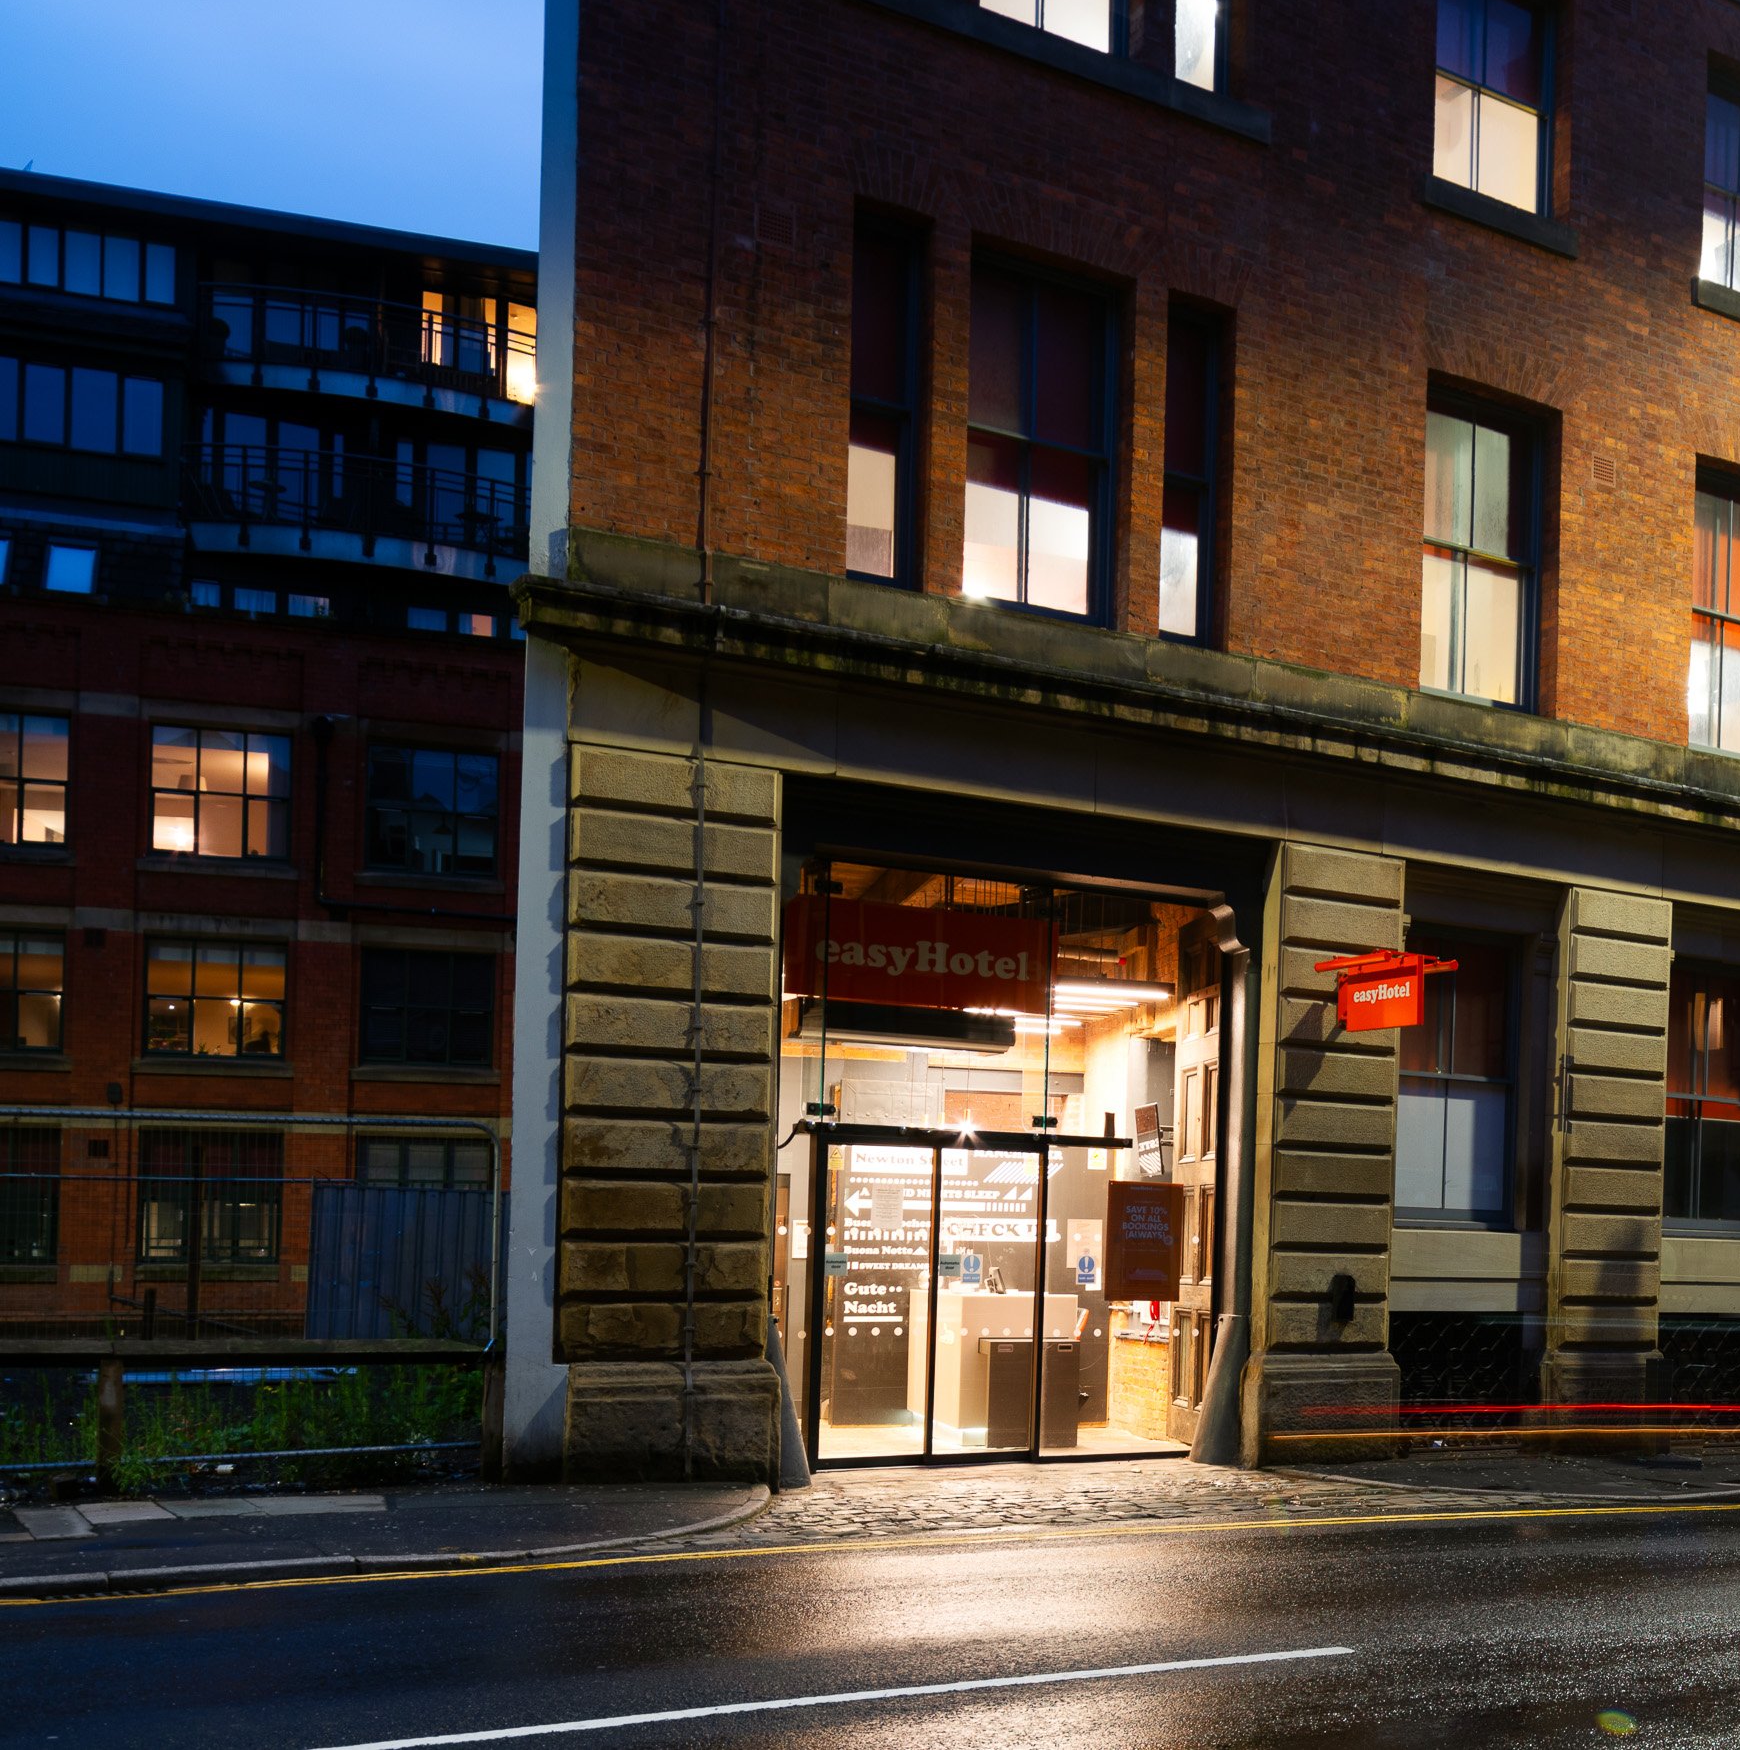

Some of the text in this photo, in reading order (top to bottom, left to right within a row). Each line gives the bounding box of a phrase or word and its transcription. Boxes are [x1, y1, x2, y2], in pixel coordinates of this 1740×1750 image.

[815, 938, 1030, 982] easyHotel
[1352, 981, 1411, 1005] easyHotel
[855, 1153, 915, 1166] Newton
[918, 1155, 964, 1168] Steet
[1126, 1206, 1147, 1215] SAVE
[1131, 1214, 1162, 1224] ON ALL
[1122, 1222, 1169, 1232] BOOKINGS
[843, 1246, 914, 1256] Buona Notte
[844, 1282, 887, 1296] Gute
[844, 1301, 897, 1315] Nacht
